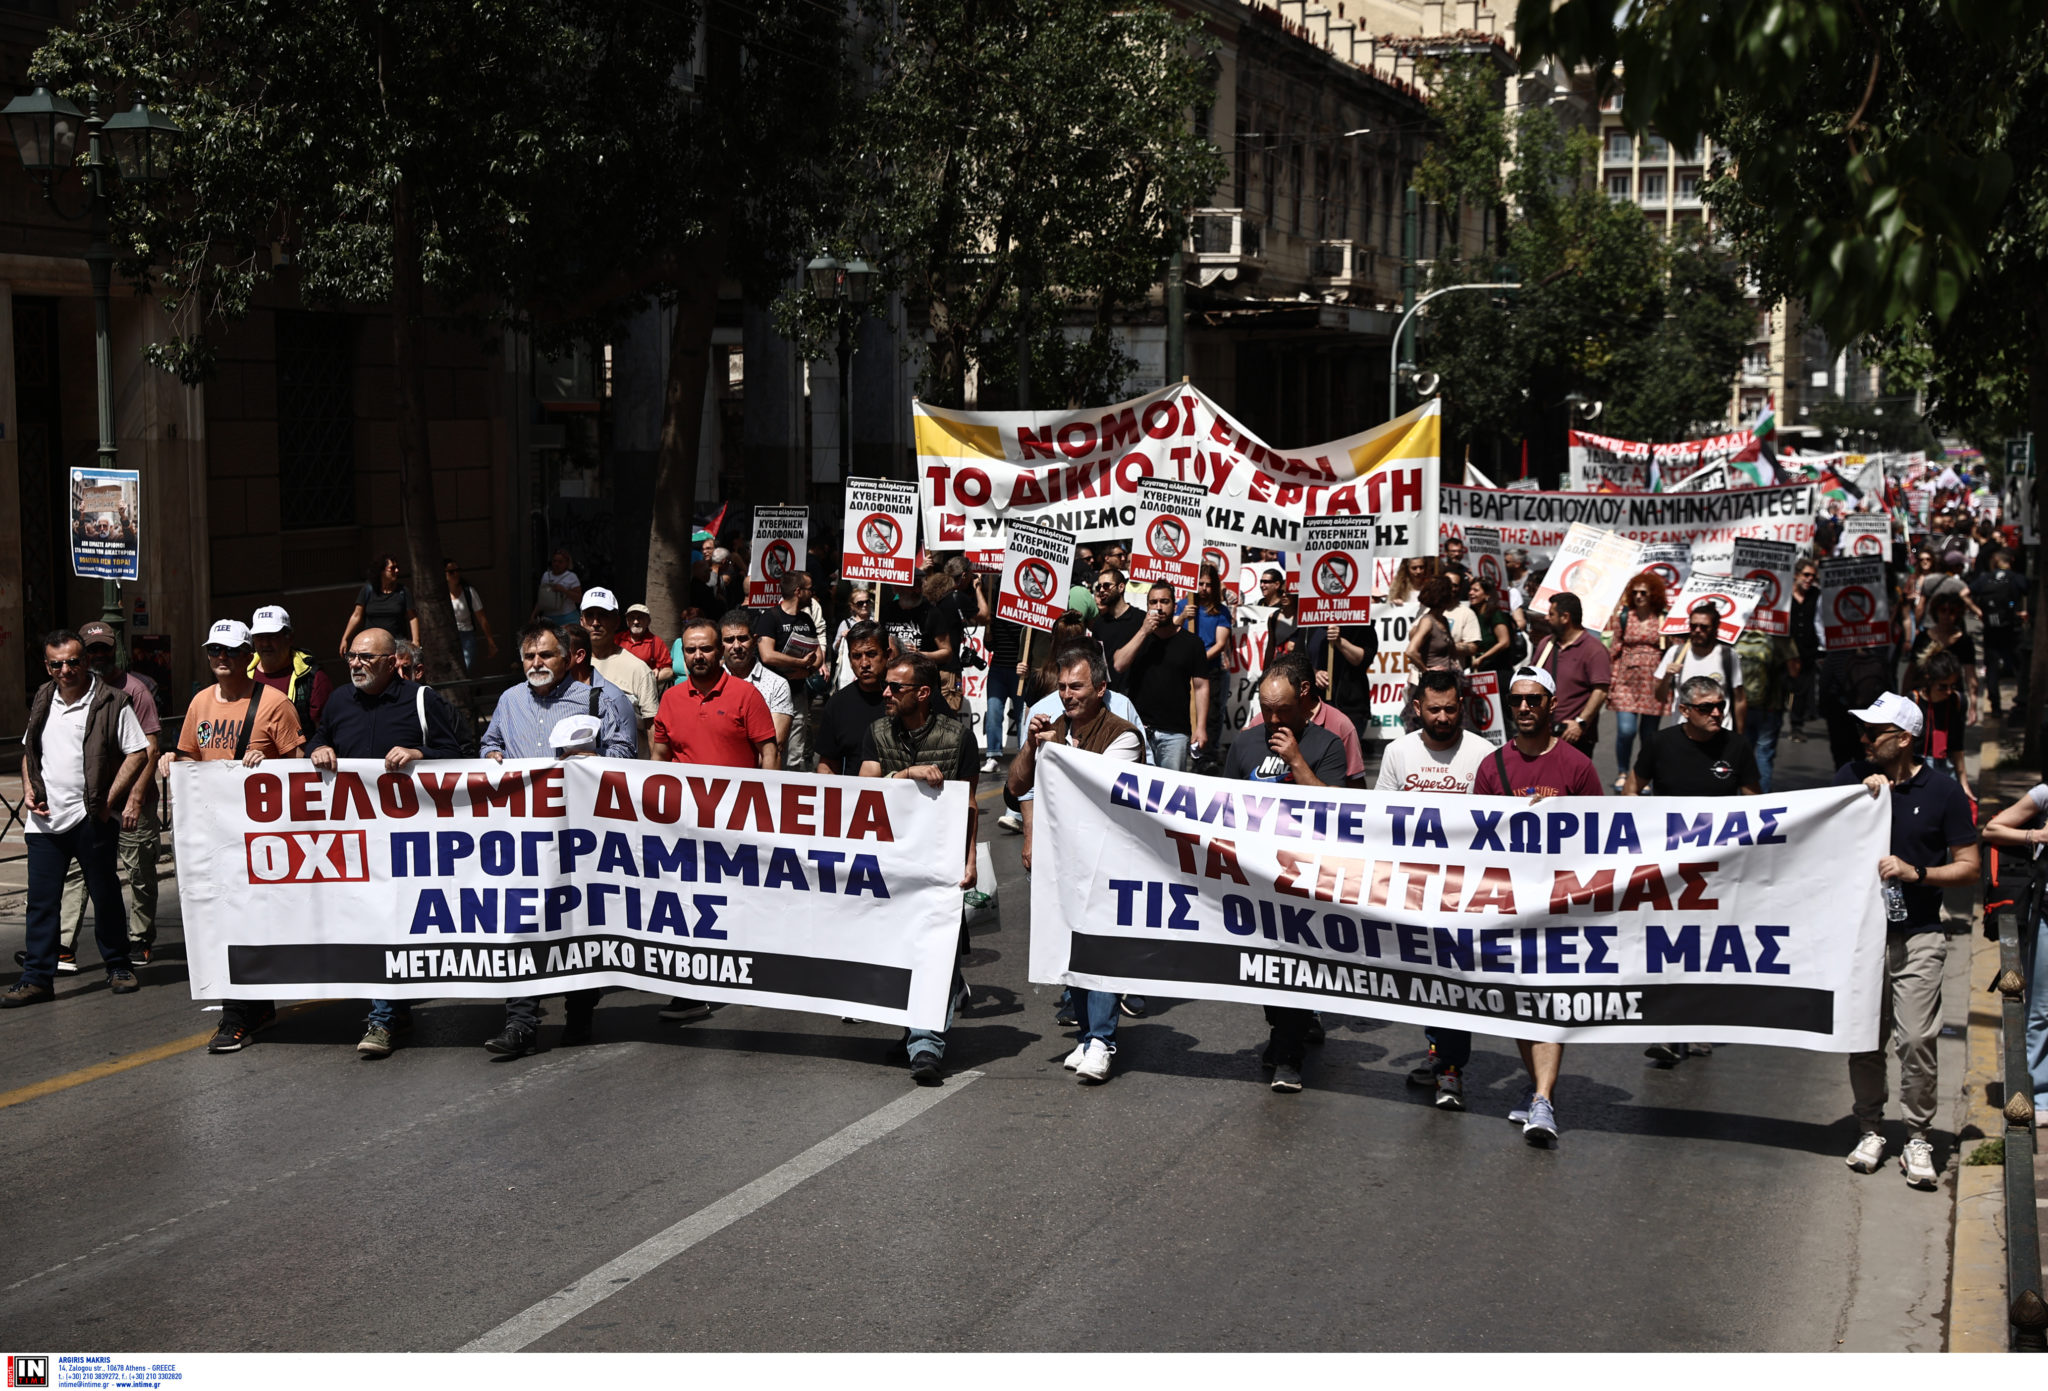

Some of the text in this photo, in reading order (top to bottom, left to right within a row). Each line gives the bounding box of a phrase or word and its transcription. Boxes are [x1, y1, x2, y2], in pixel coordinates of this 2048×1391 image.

[926, 446, 1422, 516] ΤΟ ΔΙΚΙΟ ΤΟΥ ΕΡΓΑΤΗ
[853, 490, 911, 504] ΚΥΒΕΡΝΗΣΗ
[1143, 490, 1200, 507] ΚΥΒΕΡΝΗΣΗ
[850, 501, 913, 515] ΔΟΛΟΦΟΝΩΝ
[1140, 500, 1202, 519] ΔΟΛΟΦΟΝΩΝ
[1470, 491, 1624, 525] ΒΑΡΤΖΟΠΟΥΛΟΥ
[759, 519, 803, 529] ΚΥΒΕΡΝΗΣΗ
[756, 530, 804, 539] ΔΟΛΟΦΟΝΩΝ
[1013, 531, 1069, 555] ΚΥΒΕΡΝΗΣΗ
[1308, 529, 1367, 540] ΚΥΒΕΡΝΗΣΗ
[1009, 541, 1069, 566] ΔΟΛΟΦΟΝΩΝ
[1305, 540, 1369, 551] ΔΟΛΟΦΟΝΩΝ
[862, 556, 895, 569] ΝΑ ΤΗΝ
[1150, 558, 1181, 573] ΝΑ ΤΗΝ
[846, 566, 910, 583] ΑΝΑΤΡΕΨΟΥΜΕ
[1132, 567, 1195, 588] ΑΝΑΤΡΕΨΟΥΜΕ
[1017, 598, 1048, 616] ΝΑ ΤΗΝ
[1317, 598, 1349, 610] ΝΑ ΤΗΝ
[1301, 609, 1366, 623] ΑΝΑΤΡΕΨΟΥΜΕ
[1420, 766, 1449, 774] VINTAGE
[244, 767, 893, 842] ΘΕΛΟΥΜΕ ΔΟΥΛΕΙΑ
[1110, 772, 1788, 855] ΔΙΑΛΥΕΤΕ ΤΑ ΧΩΡΙΑ ΜΑΣ
[251, 827, 891, 900] ΟΧΙ ΠΡΟΓΡΑΜΜΑΤΑ
[1164, 829, 1720, 916] ΤΑ ΣΠΙΤΙΑ ΜΑΣ
[409, 884, 728, 940] ΑΝΕΡΓΙΑΣ
[1109, 878, 1791, 975] ΤΙΣ ΟΙΚΟΓΕΝΕΙΕΣ ΜΑΣ
[385, 943, 753, 986] ΜΕΤΑΛΛΕΙΑ ΛΑΡΚΟ ΕΥΒΟΙΑΣ
[1238, 951, 1643, 1022] ΜΕΤΑΛΛΕΙΑ ΛΑΡΚΟ ΕΥΒΟΙΑΣ
